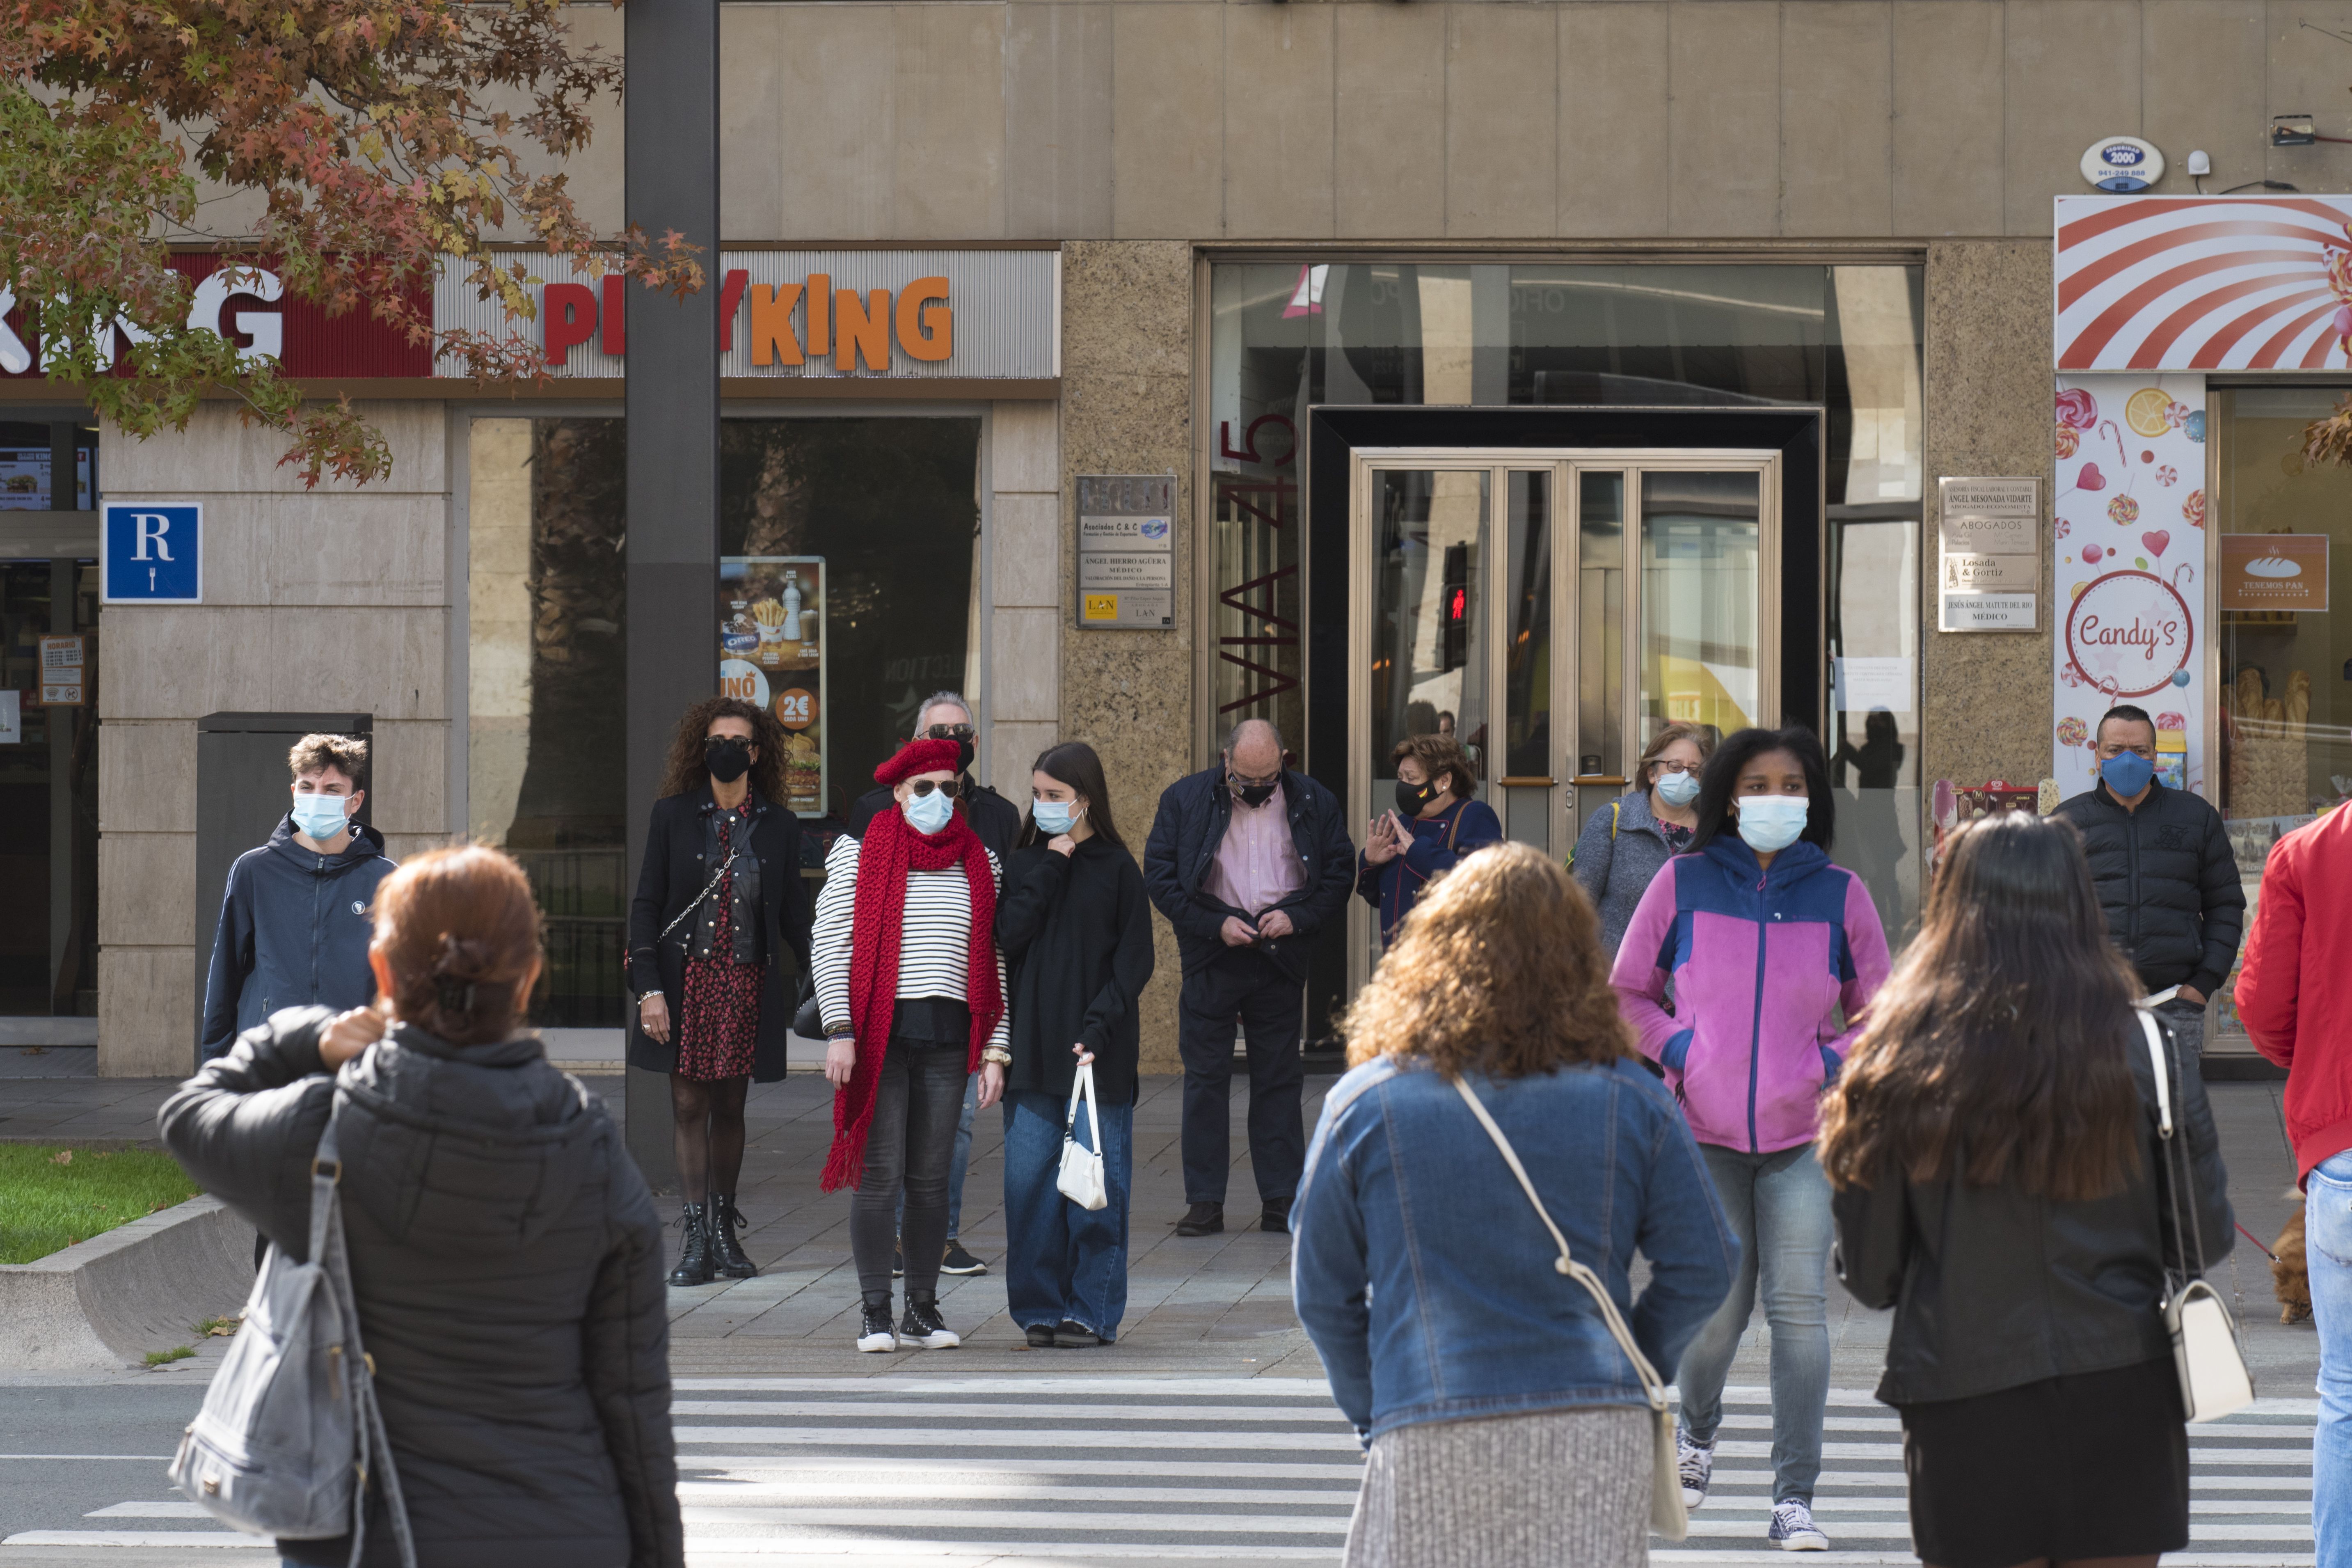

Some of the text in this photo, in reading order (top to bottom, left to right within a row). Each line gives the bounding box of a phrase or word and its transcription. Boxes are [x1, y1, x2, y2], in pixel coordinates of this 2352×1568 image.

[2105, 145, 2140, 154] SEGURIDAD
[2111, 152, 2135, 163] 2000
[1949, 493, 2032, 503] ÁNGEL MESONADA VIDARTE
[1960, 521, 2022, 530] ABOGADOS
[130, 513, 175, 561] R
[1085, 556, 1108, 565] ÁNGEL
[1962, 559, 1996, 567] Losada
[1973, 568, 2003, 577] Górtiz
[1089, 600, 1114, 610] LAN
[1948, 600, 1964, 609] JESÚS
[1965, 600, 1984, 609] ÁNGEL
[1972, 612, 2008, 620] MÉDICO
[47, 641, 76, 650] HORARIO
[728, 636, 756, 646] OREO
[784, 695, 808, 716] 2€
